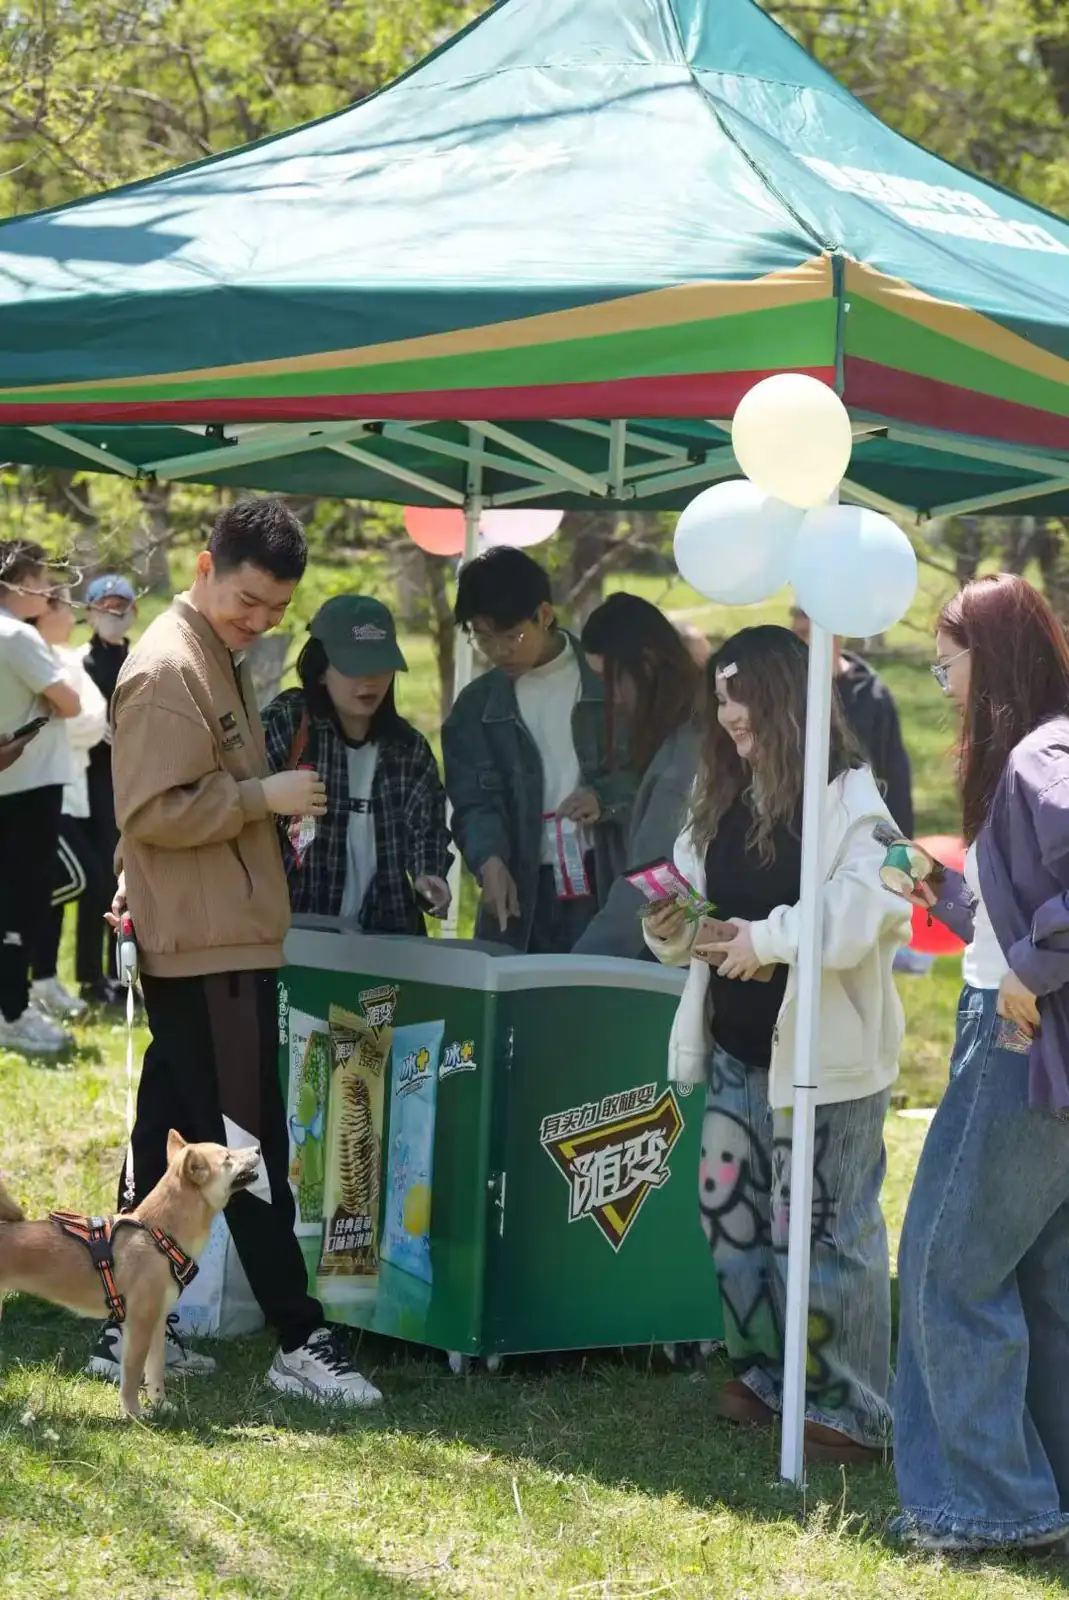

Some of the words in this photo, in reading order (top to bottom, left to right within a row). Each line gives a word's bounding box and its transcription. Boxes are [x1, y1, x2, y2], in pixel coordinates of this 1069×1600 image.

[602, 1085, 655, 1118] 敢随变
[570, 1127, 671, 1216] 随变
